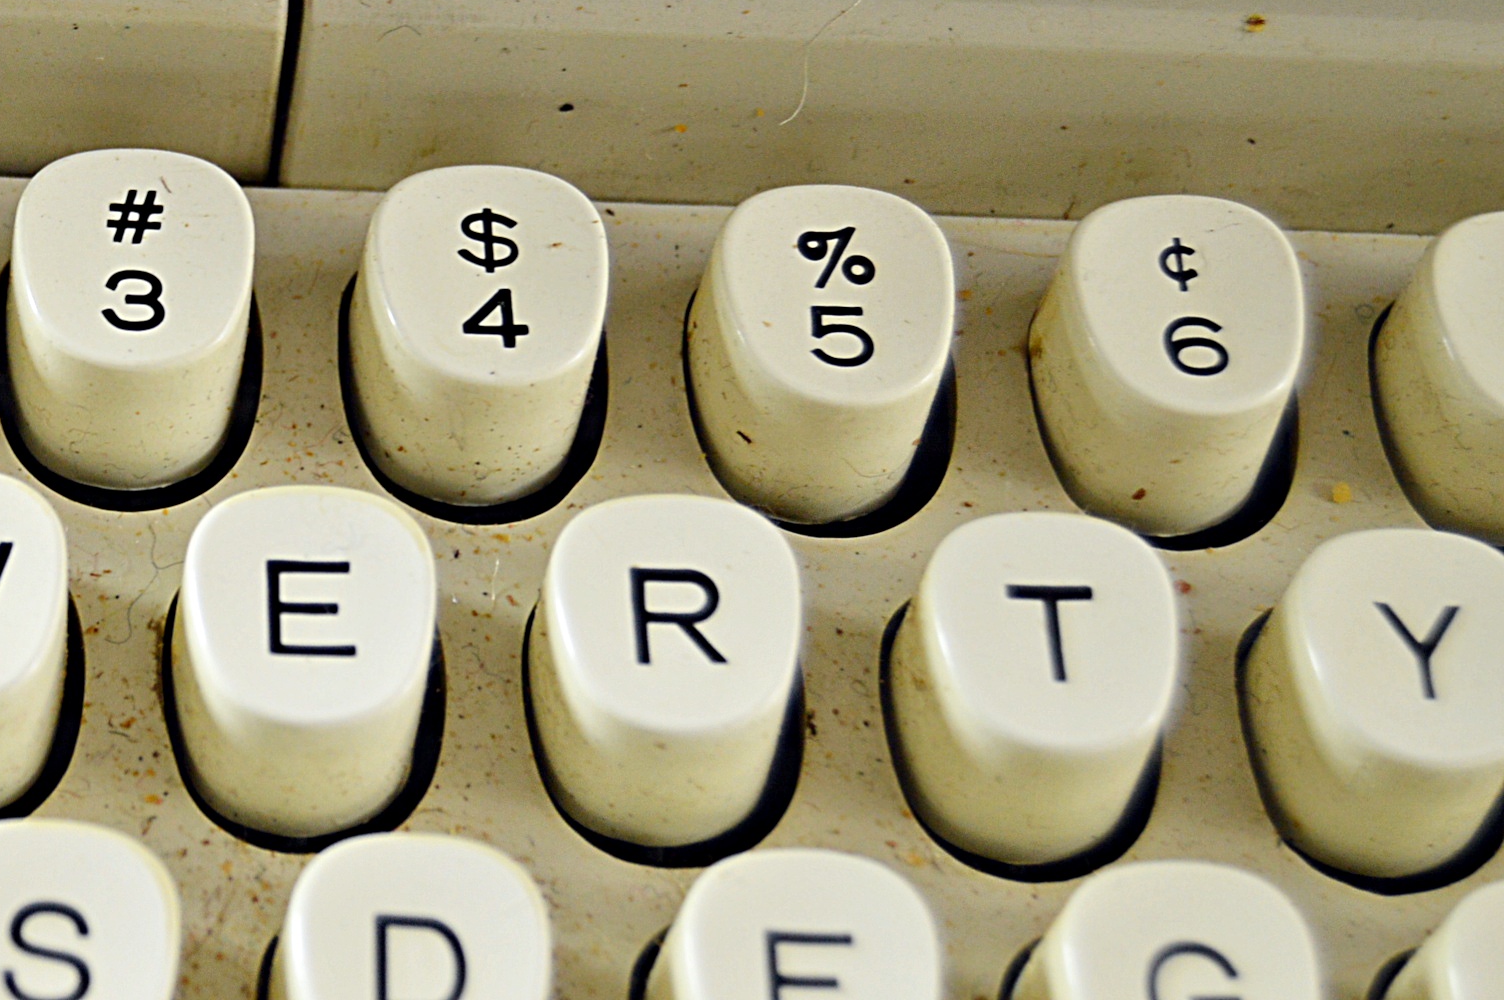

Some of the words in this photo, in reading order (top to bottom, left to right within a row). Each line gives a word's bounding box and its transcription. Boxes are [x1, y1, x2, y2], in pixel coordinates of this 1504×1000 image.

[106, 189, 164, 245] #
[457, 207, 519, 274] $
[796, 226, 876, 289] %
[1159, 237, 1199, 292] ¢
[101, 269, 166, 332] 3
[462, 288, 530, 349] 4
[810, 305, 875, 368] 5
[1164, 316, 1230, 377] 6
[266, 559, 357, 657] E
[629, 567, 728, 665] R
[1006, 584, 1094, 682] T
[1375, 602, 1460, 700] Y
[3, 901, 91, 1000] S
[375, 914, 468, 1000] D
